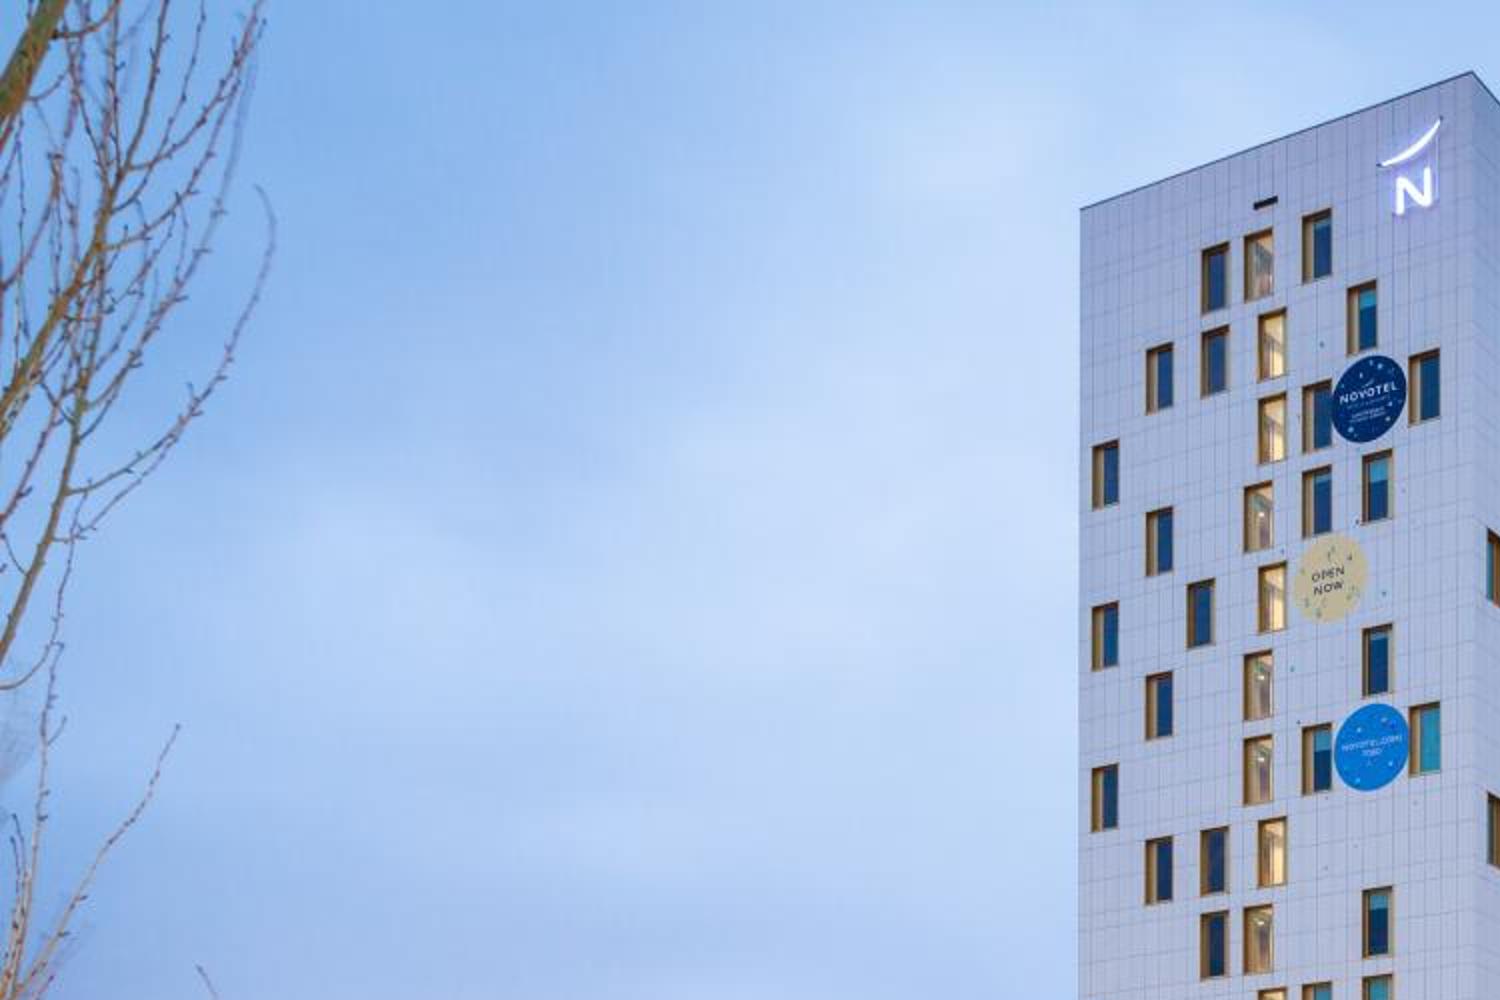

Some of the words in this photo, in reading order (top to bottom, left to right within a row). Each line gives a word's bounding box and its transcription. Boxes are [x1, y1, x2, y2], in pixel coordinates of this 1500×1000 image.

[1396, 166, 1433, 216] N
[1339, 381, 1400, 405] NOVOTEL
[1311, 565, 1345, 583] OPEN
[1313, 580, 1344, 596] NOW
